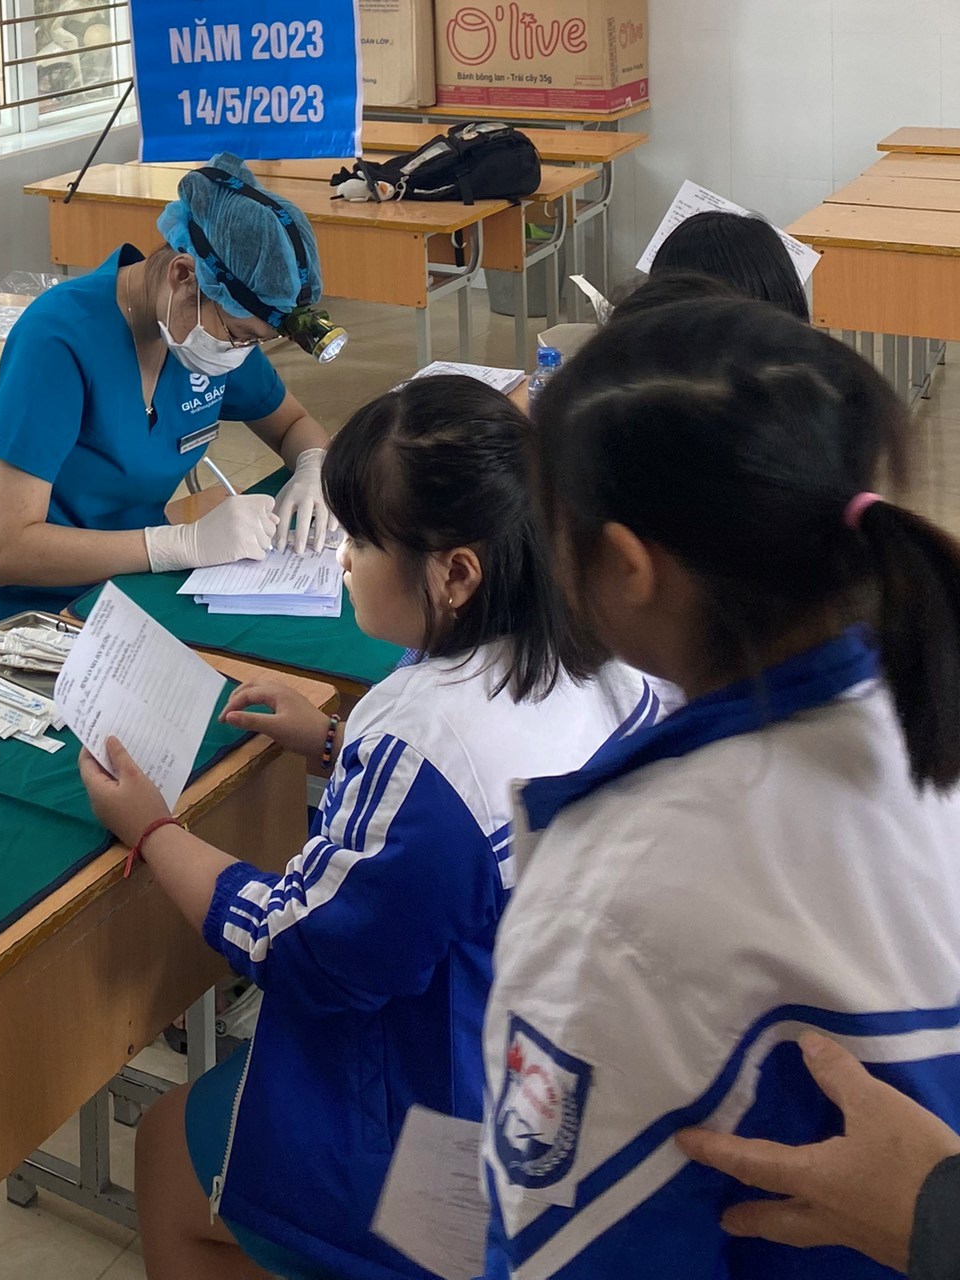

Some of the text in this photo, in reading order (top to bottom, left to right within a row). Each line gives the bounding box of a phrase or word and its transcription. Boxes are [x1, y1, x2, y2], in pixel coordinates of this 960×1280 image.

[168, 17, 324, 65] NĂM 2023
[446, 2, 587, 66] O'live
[457, 71, 474, 81] Bánh
[494, 73, 505, 82] lan
[539, 74, 553, 84] 35g
[177, 84, 325, 126] 14/5/2023
[181, 398, 202, 412] GIA
